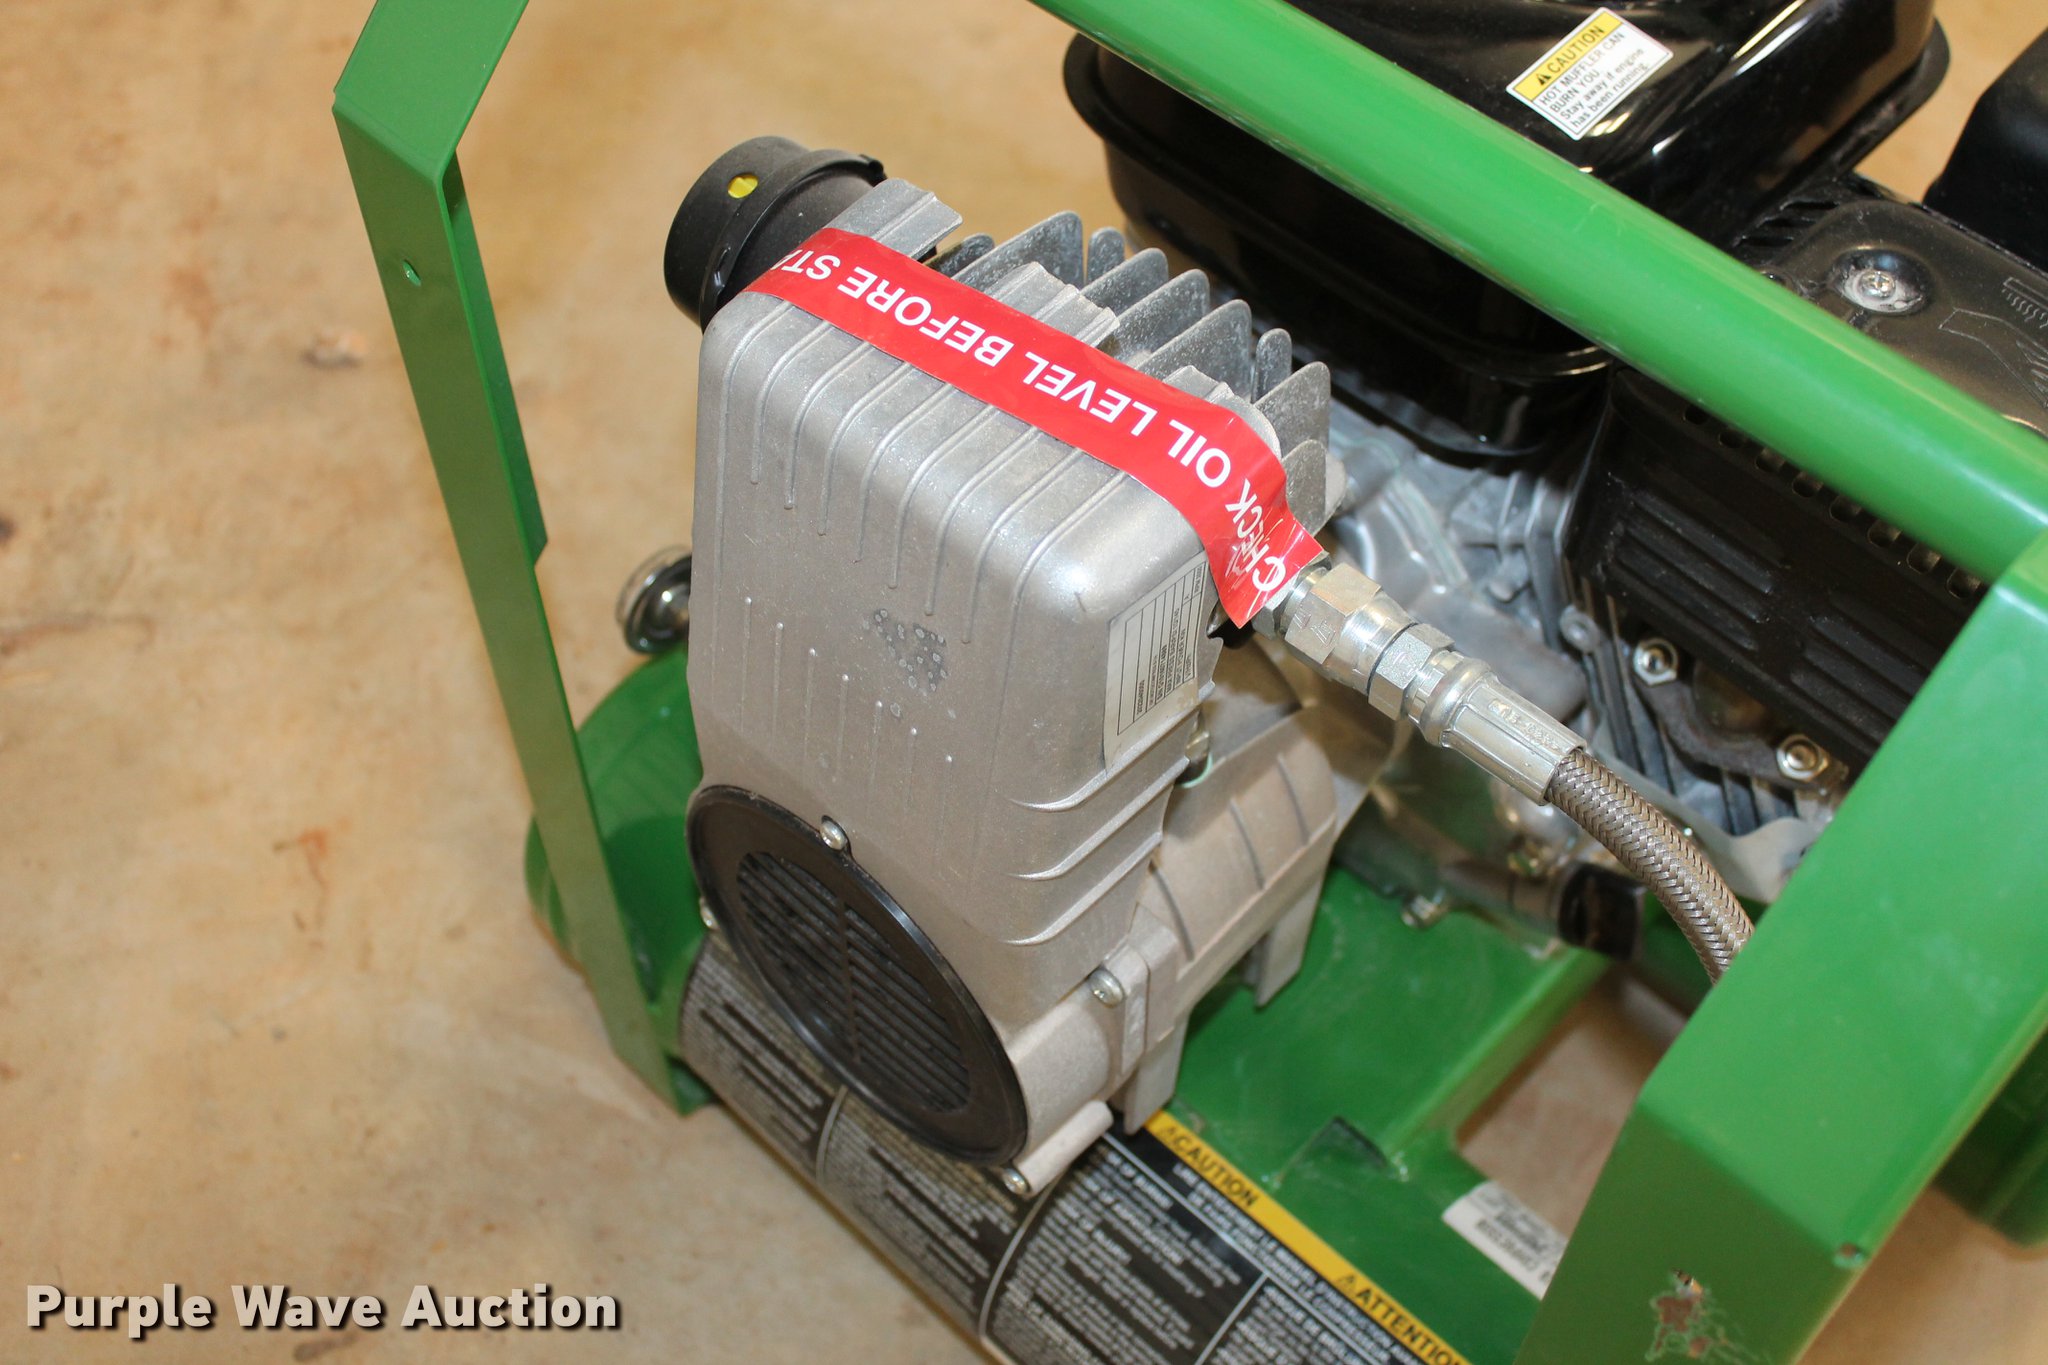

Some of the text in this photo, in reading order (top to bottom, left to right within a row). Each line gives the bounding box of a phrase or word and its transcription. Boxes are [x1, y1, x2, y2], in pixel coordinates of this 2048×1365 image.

[1538, 32, 1625, 105] HOT MUFFLER CAN
[1547, 25, 1605, 74] CAUTION
[1560, 49, 1644, 120] Stay away if engine
[1550, 69, 1600, 113] BURN YOU
[1571, 62, 1650, 127] has been running
[837, 266, 1014, 367] BEFORE
[1023, 351, 1158, 436] LEVEL
[1168, 418, 1231, 488] OIL
[1174, 1135, 1259, 1207] CAUTION
[1356, 1287, 1461, 1365] ATTENTIO
